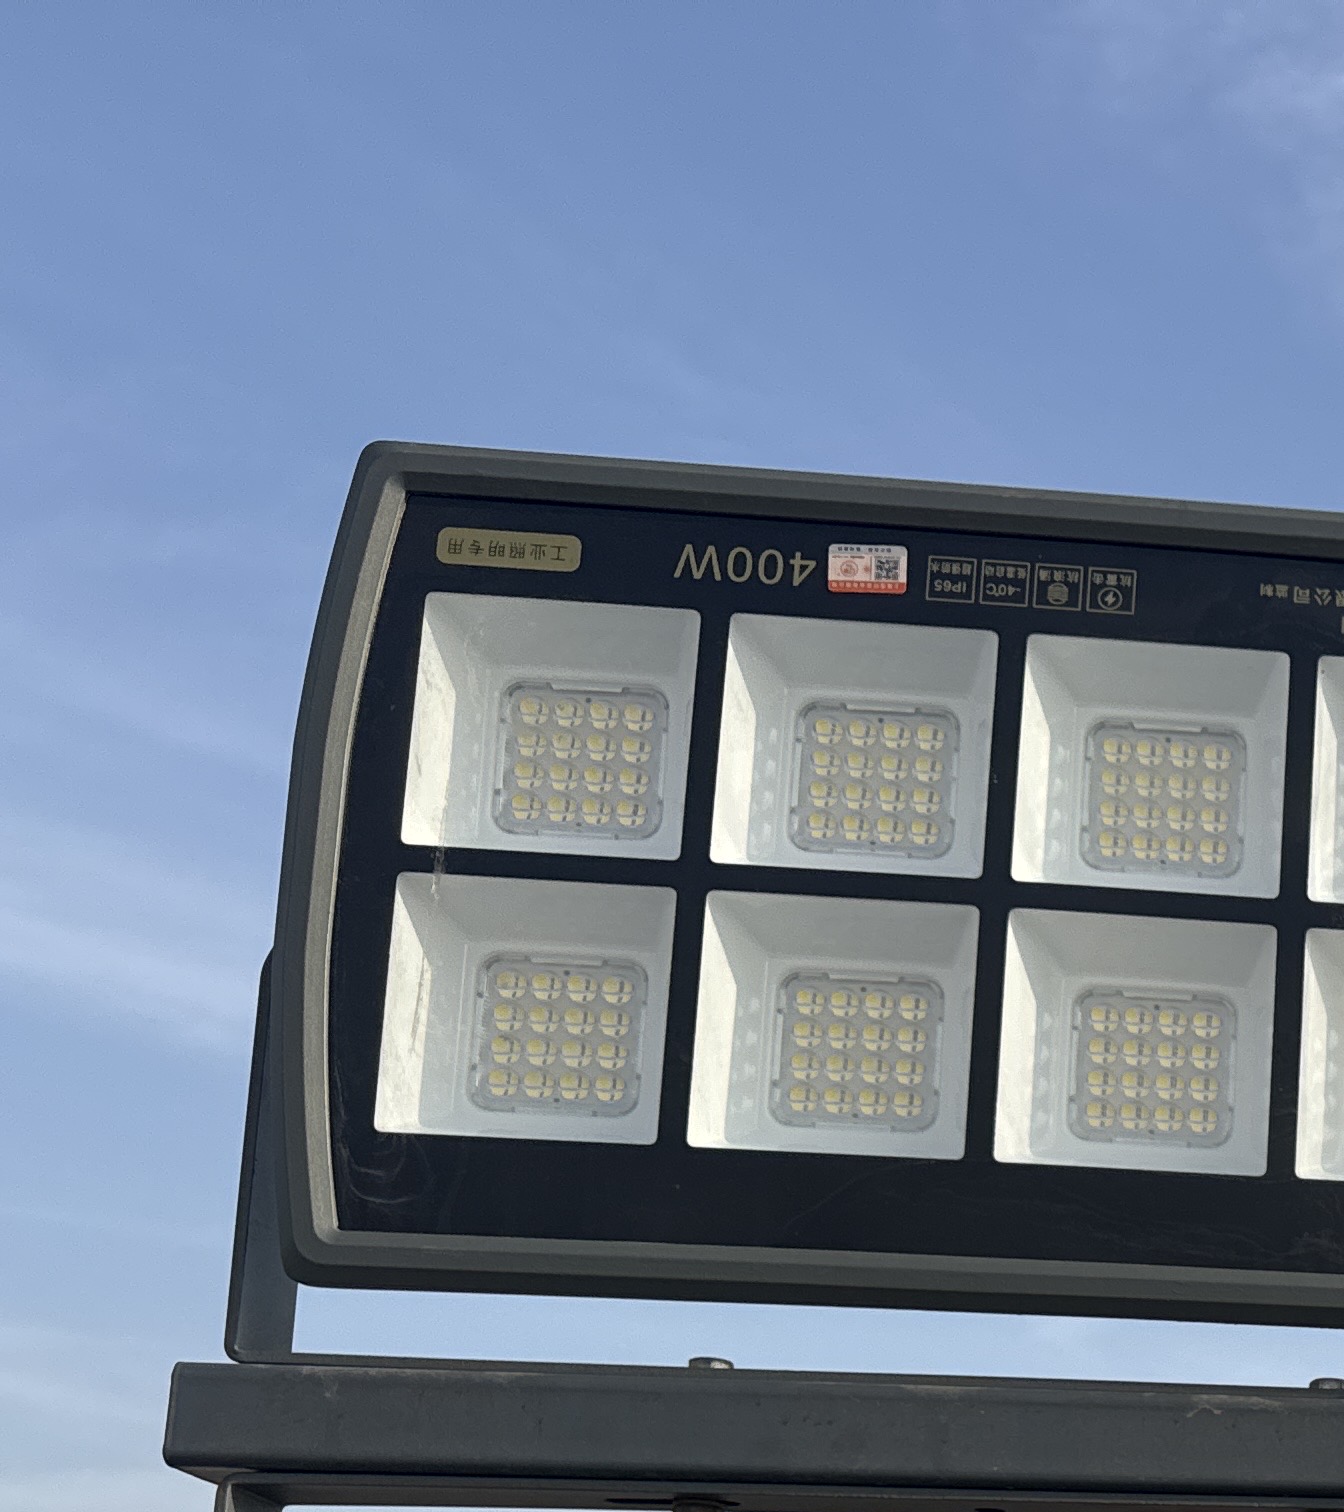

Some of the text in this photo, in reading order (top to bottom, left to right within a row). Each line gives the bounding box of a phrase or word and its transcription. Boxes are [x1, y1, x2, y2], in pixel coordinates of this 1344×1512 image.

[446, 537, 568, 562] 工业照明专用
[673, 542, 817, 587] 400W
[934, 579, 966, 593] IP65
